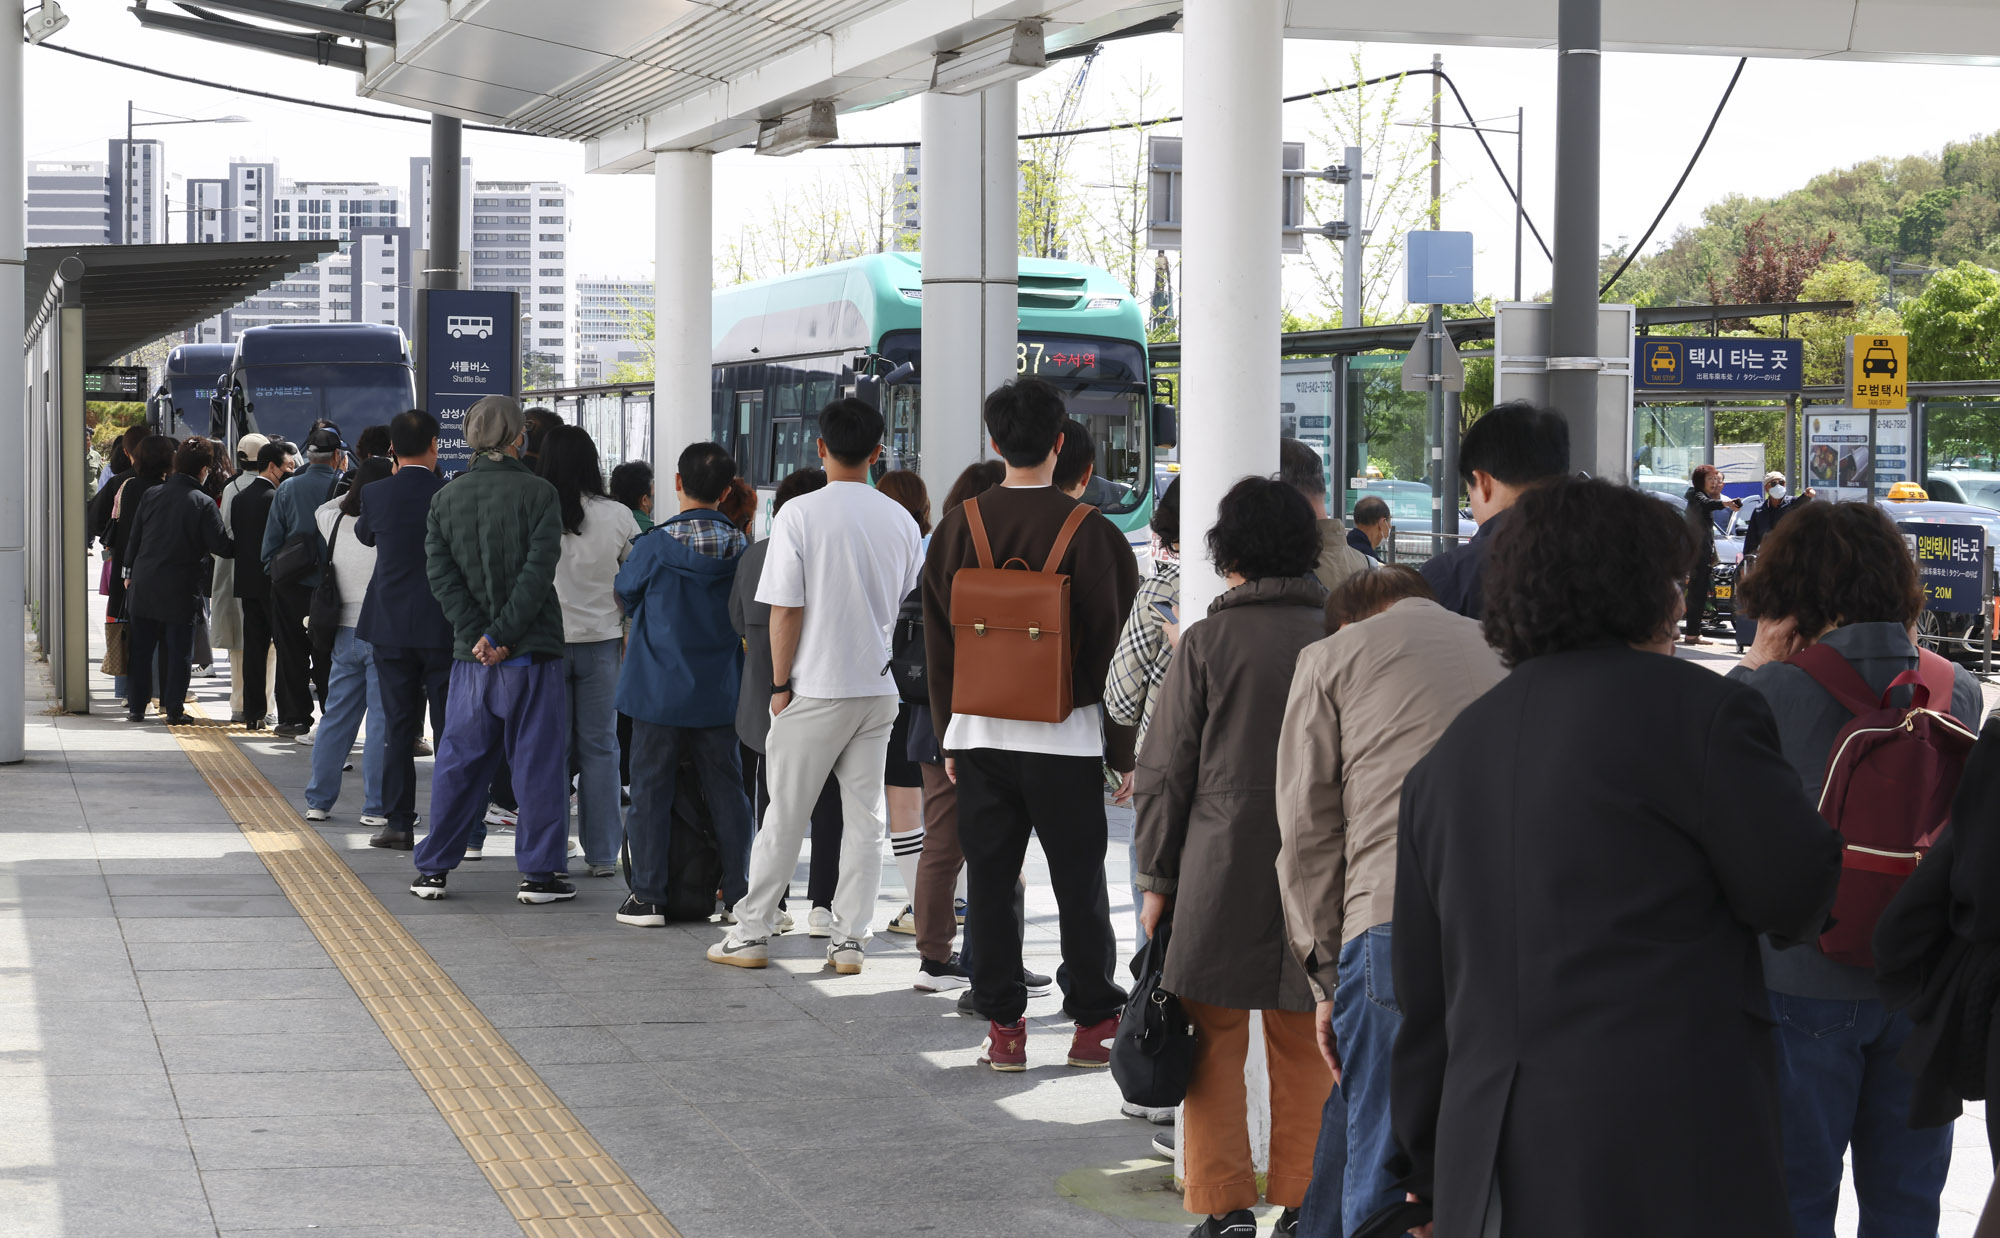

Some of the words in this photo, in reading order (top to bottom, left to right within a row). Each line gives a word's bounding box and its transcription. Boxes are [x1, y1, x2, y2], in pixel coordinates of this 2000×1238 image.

[1053, 352, 1095, 368] 수서역
[1689, 348, 1723, 369] 택시
[1731, 348, 1765, 369] 타는
[1770, 350, 1789, 370] 곳
[449, 361, 491, 373] 셔틀버스
[452, 375, 474, 383] Shuttle
[1743, 373, 1781, 381] タクシーのりば
[256, 386, 313, 397] 강남세브란스
[1856, 384, 1904, 398] 모범택시
[440, 422, 463, 431] Samsung
[437, 438, 471, 449] 강남세브
[437, 453, 458, 461] angnam
[1935, 586, 1952, 599] 20M
